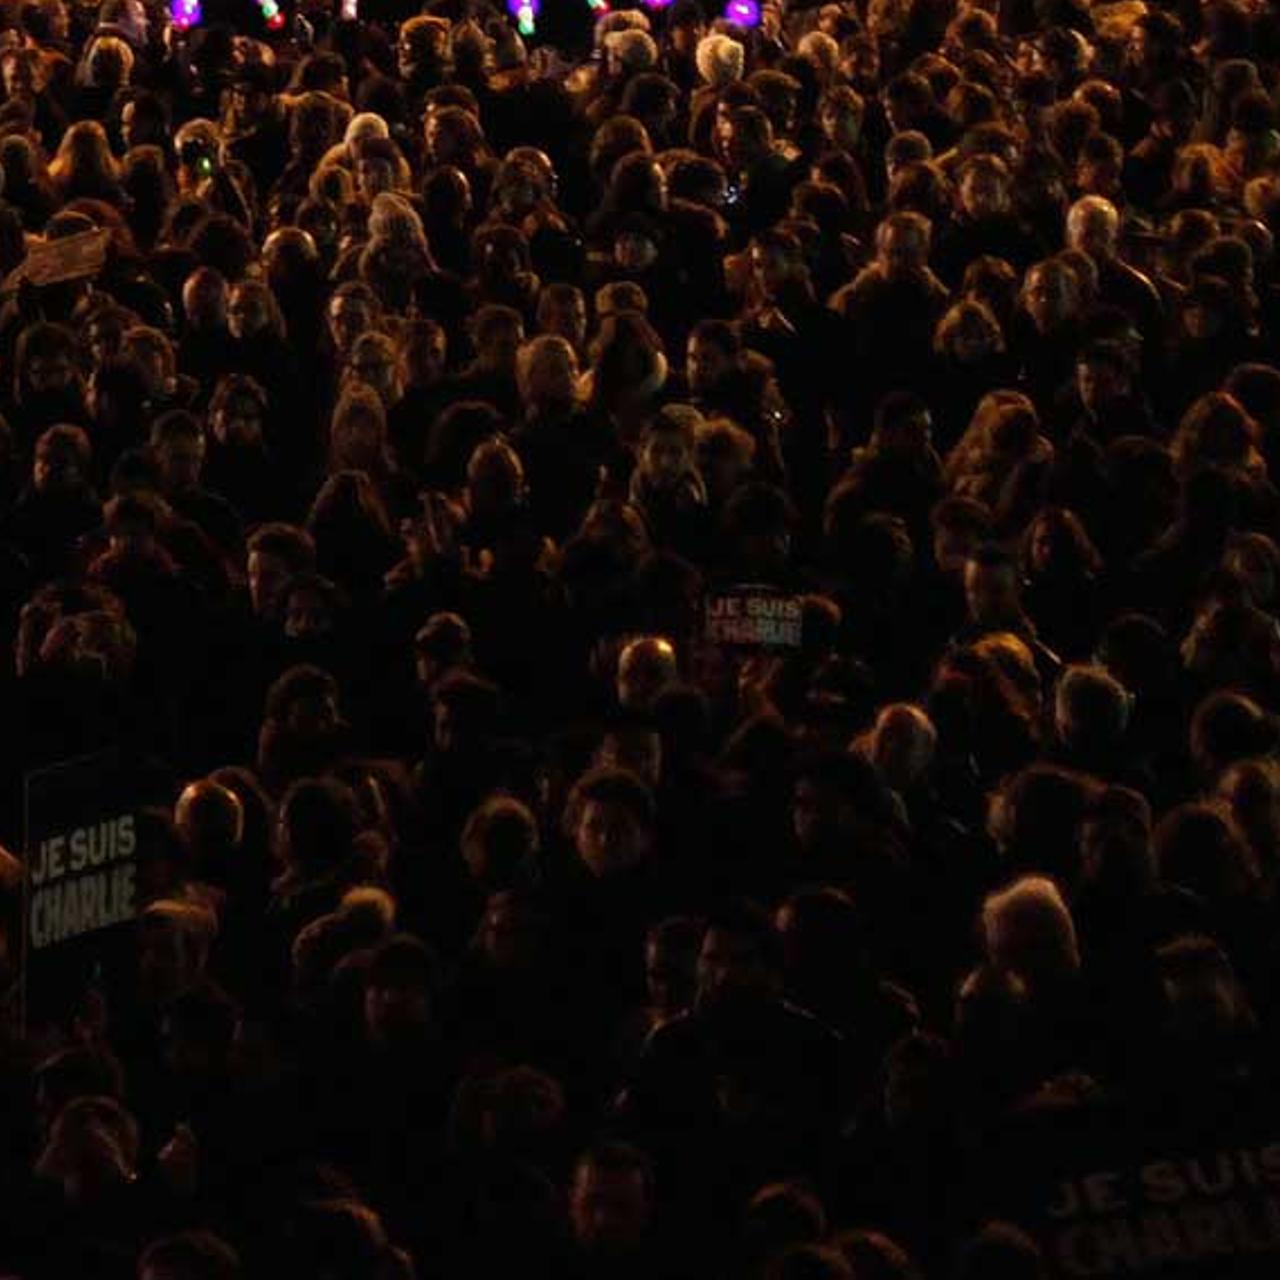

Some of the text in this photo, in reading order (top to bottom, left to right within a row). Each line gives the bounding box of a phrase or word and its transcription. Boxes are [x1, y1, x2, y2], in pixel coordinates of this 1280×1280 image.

[712, 597, 802, 620] JE SUIS
[31, 813, 136, 886] JE SUIS
[31, 862, 136, 949] CHARLIE
[1046, 1170, 1126, 1218] JE
